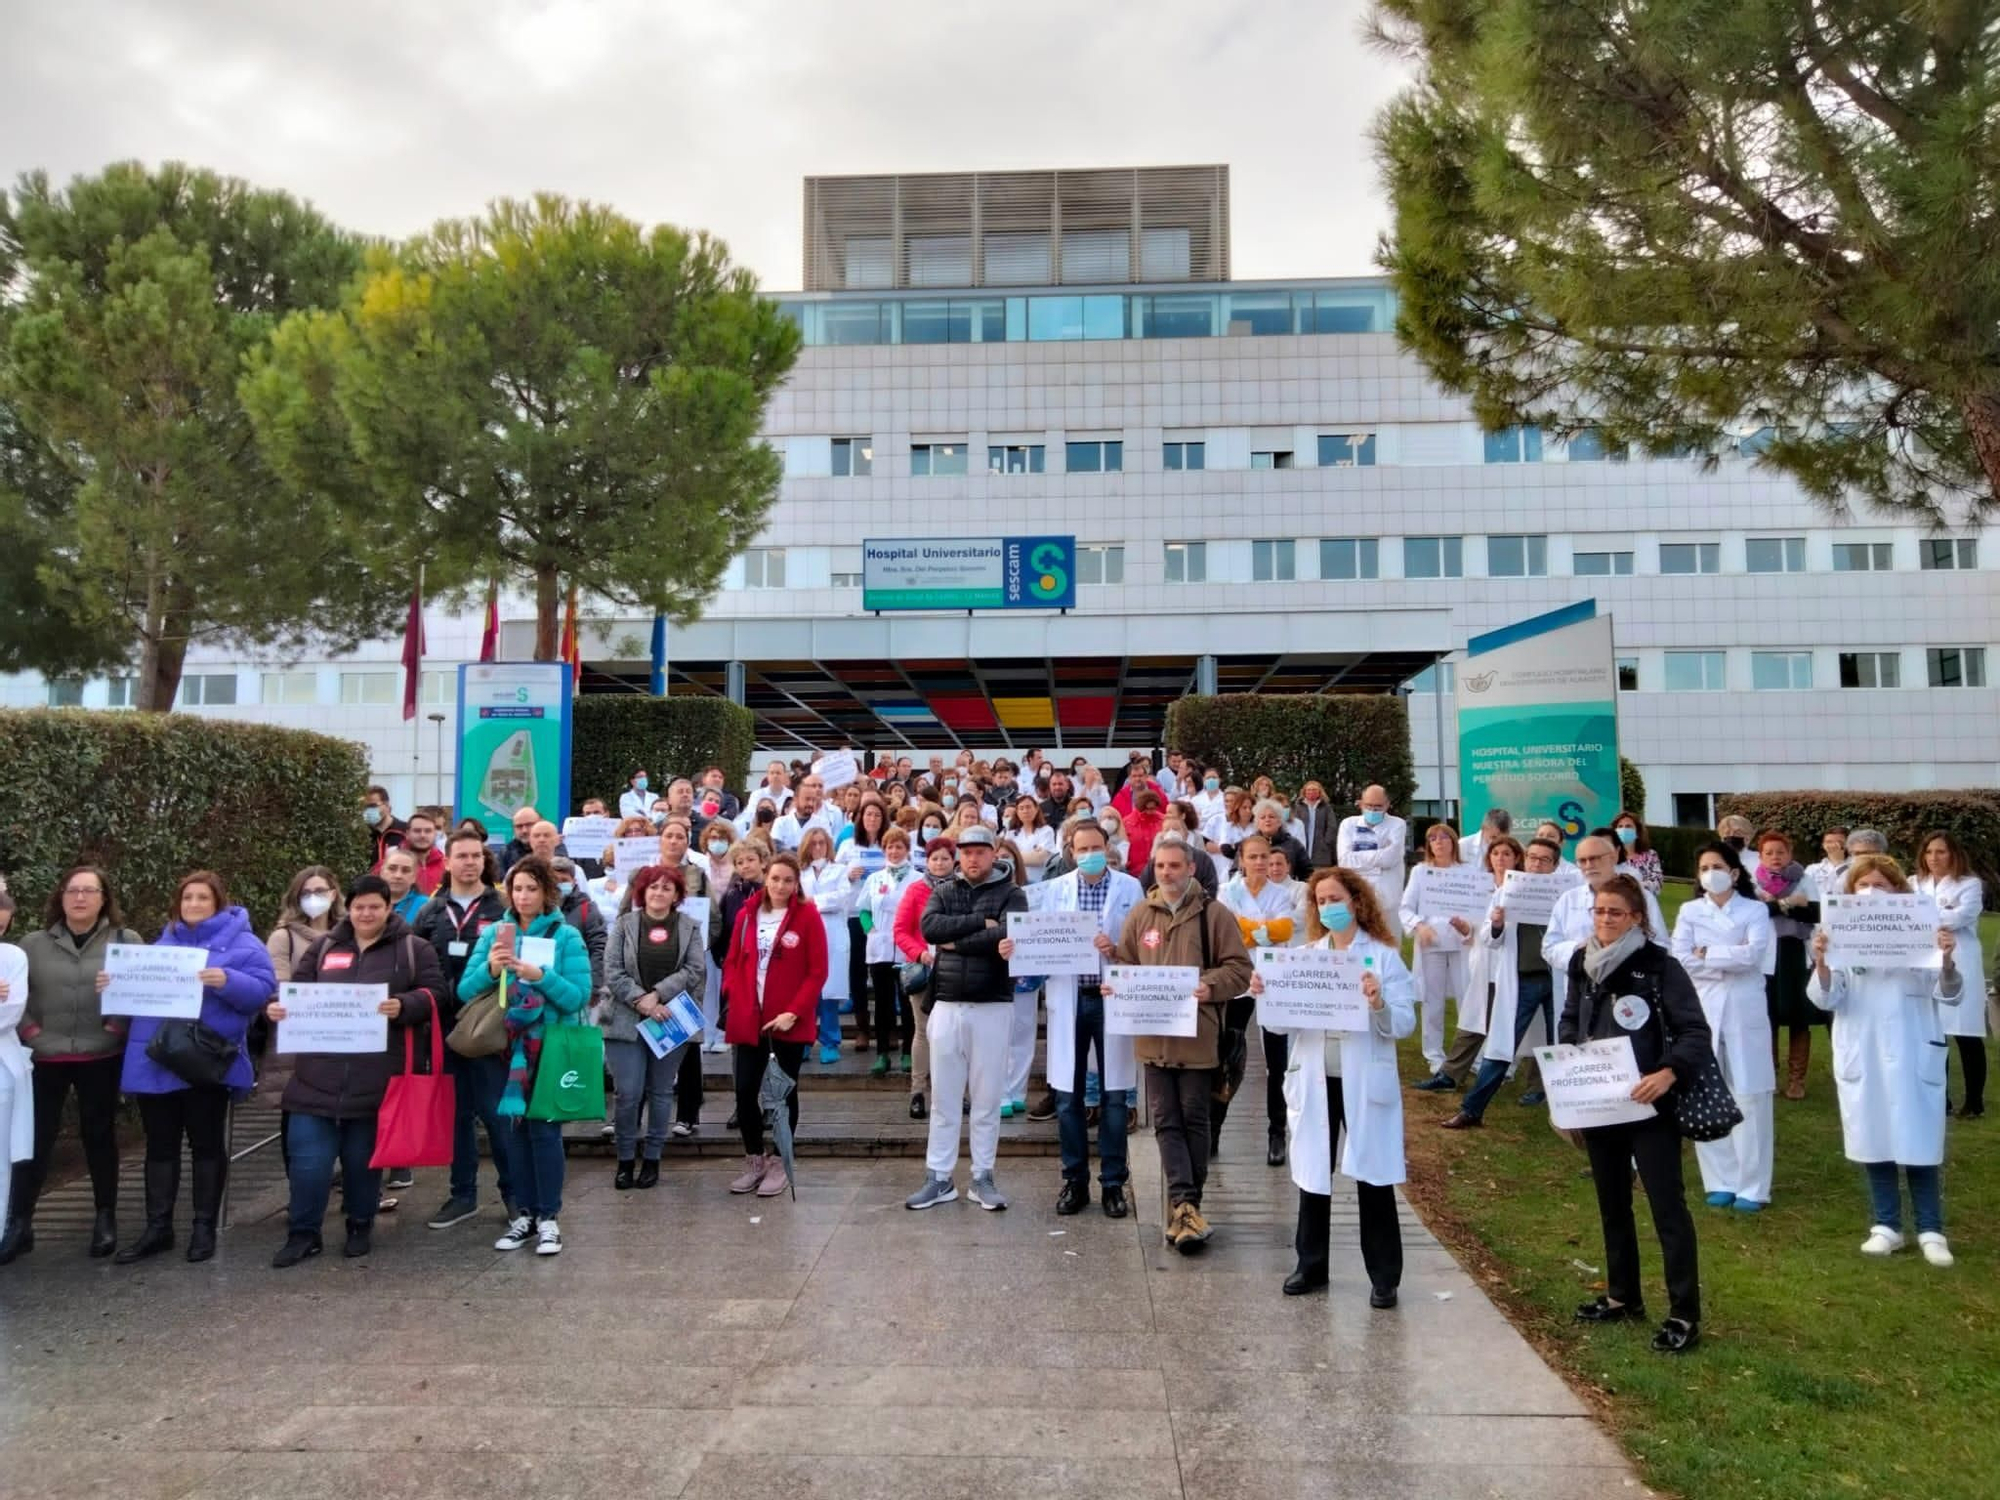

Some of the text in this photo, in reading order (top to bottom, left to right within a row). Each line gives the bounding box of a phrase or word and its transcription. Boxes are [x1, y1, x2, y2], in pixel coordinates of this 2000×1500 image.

[867, 547, 1001, 561] Hospital Universitario
[1009, 544, 1020, 601] sescam
[1472, 743, 1603, 757] HOSPITAL UNIVERSITARIO
[1472, 758, 1587, 770] NUESTRA SEÑORA DEL
[1473, 771, 1579, 783] PERPETUO SOCORRO
[1850, 914, 1911, 923] ¡¡¡CARRERA
[1831, 923, 1932, 932] PROFESIONAL YA!!!
[1016, 936, 1071, 945] PROFESIONAL
[110, 973, 173, 983] PROFESIONAL
[1265, 980, 1359, 991] PROFESIONAL YA!!!
[1114, 993, 1171, 1001] PROFESIONAL
[288, 1010, 353, 1019] PROFESIONAL
[1550, 1076, 1610, 1087] PROFESIONAL
